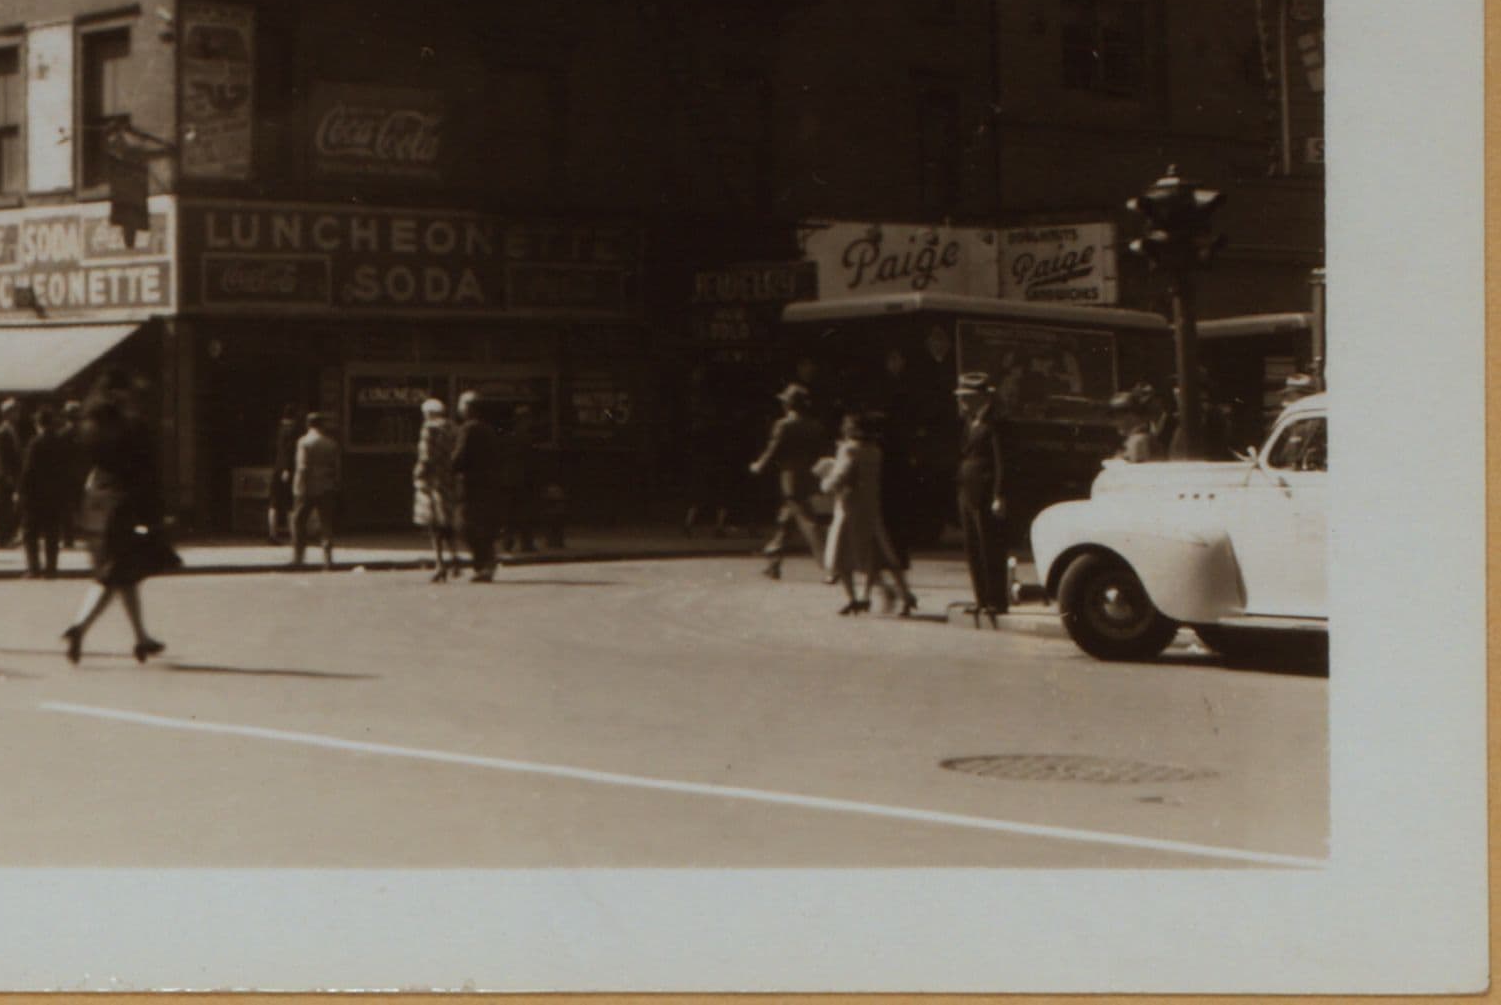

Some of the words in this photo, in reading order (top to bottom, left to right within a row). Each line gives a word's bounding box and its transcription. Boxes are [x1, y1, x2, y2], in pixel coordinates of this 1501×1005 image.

[19, 222, 81, 264] SODA
[204, 211, 624, 263] LUNCHEONETTE
[352, 264, 486, 303] SODA
[841, 236, 960, 291] Paige
[1011, 243, 1096, 285] Paige
